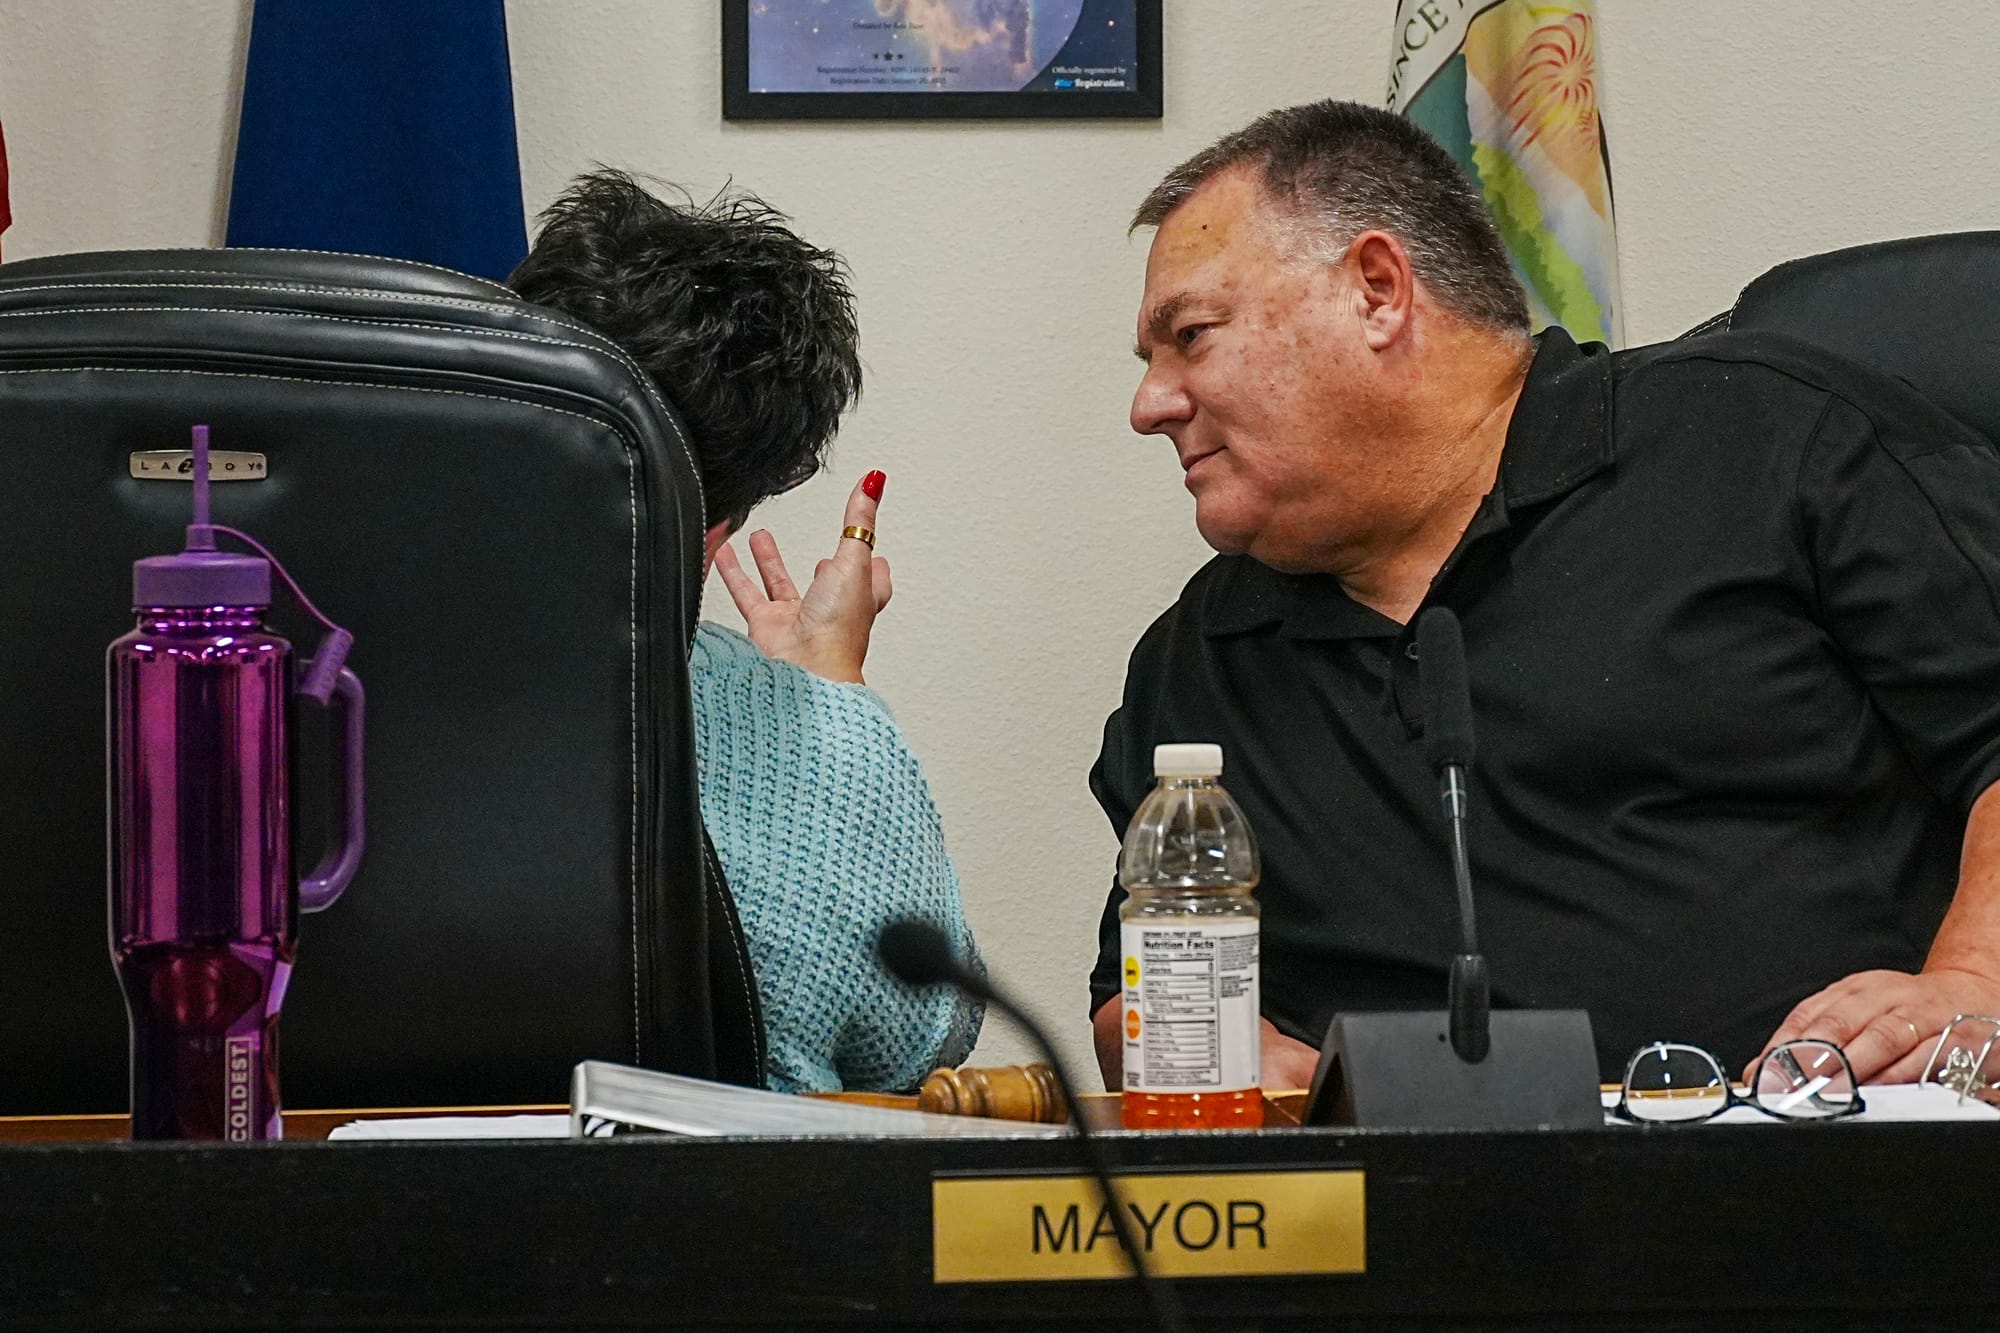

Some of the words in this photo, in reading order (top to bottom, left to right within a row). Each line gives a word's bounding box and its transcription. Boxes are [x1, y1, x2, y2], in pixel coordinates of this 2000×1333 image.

[1052, 66, 1083, 74] Officially
[1118, 67, 1126, 75] by
[1386, 0, 1449, 111] SINCE
[1074, 78, 1125, 89] Registration
[1144, 940, 1184, 950] Nutrition
[1187, 939, 1214, 950] Facts
[230, 1044, 249, 1143] COLDEST
[1031, 1199, 1269, 1254] MAYOR
